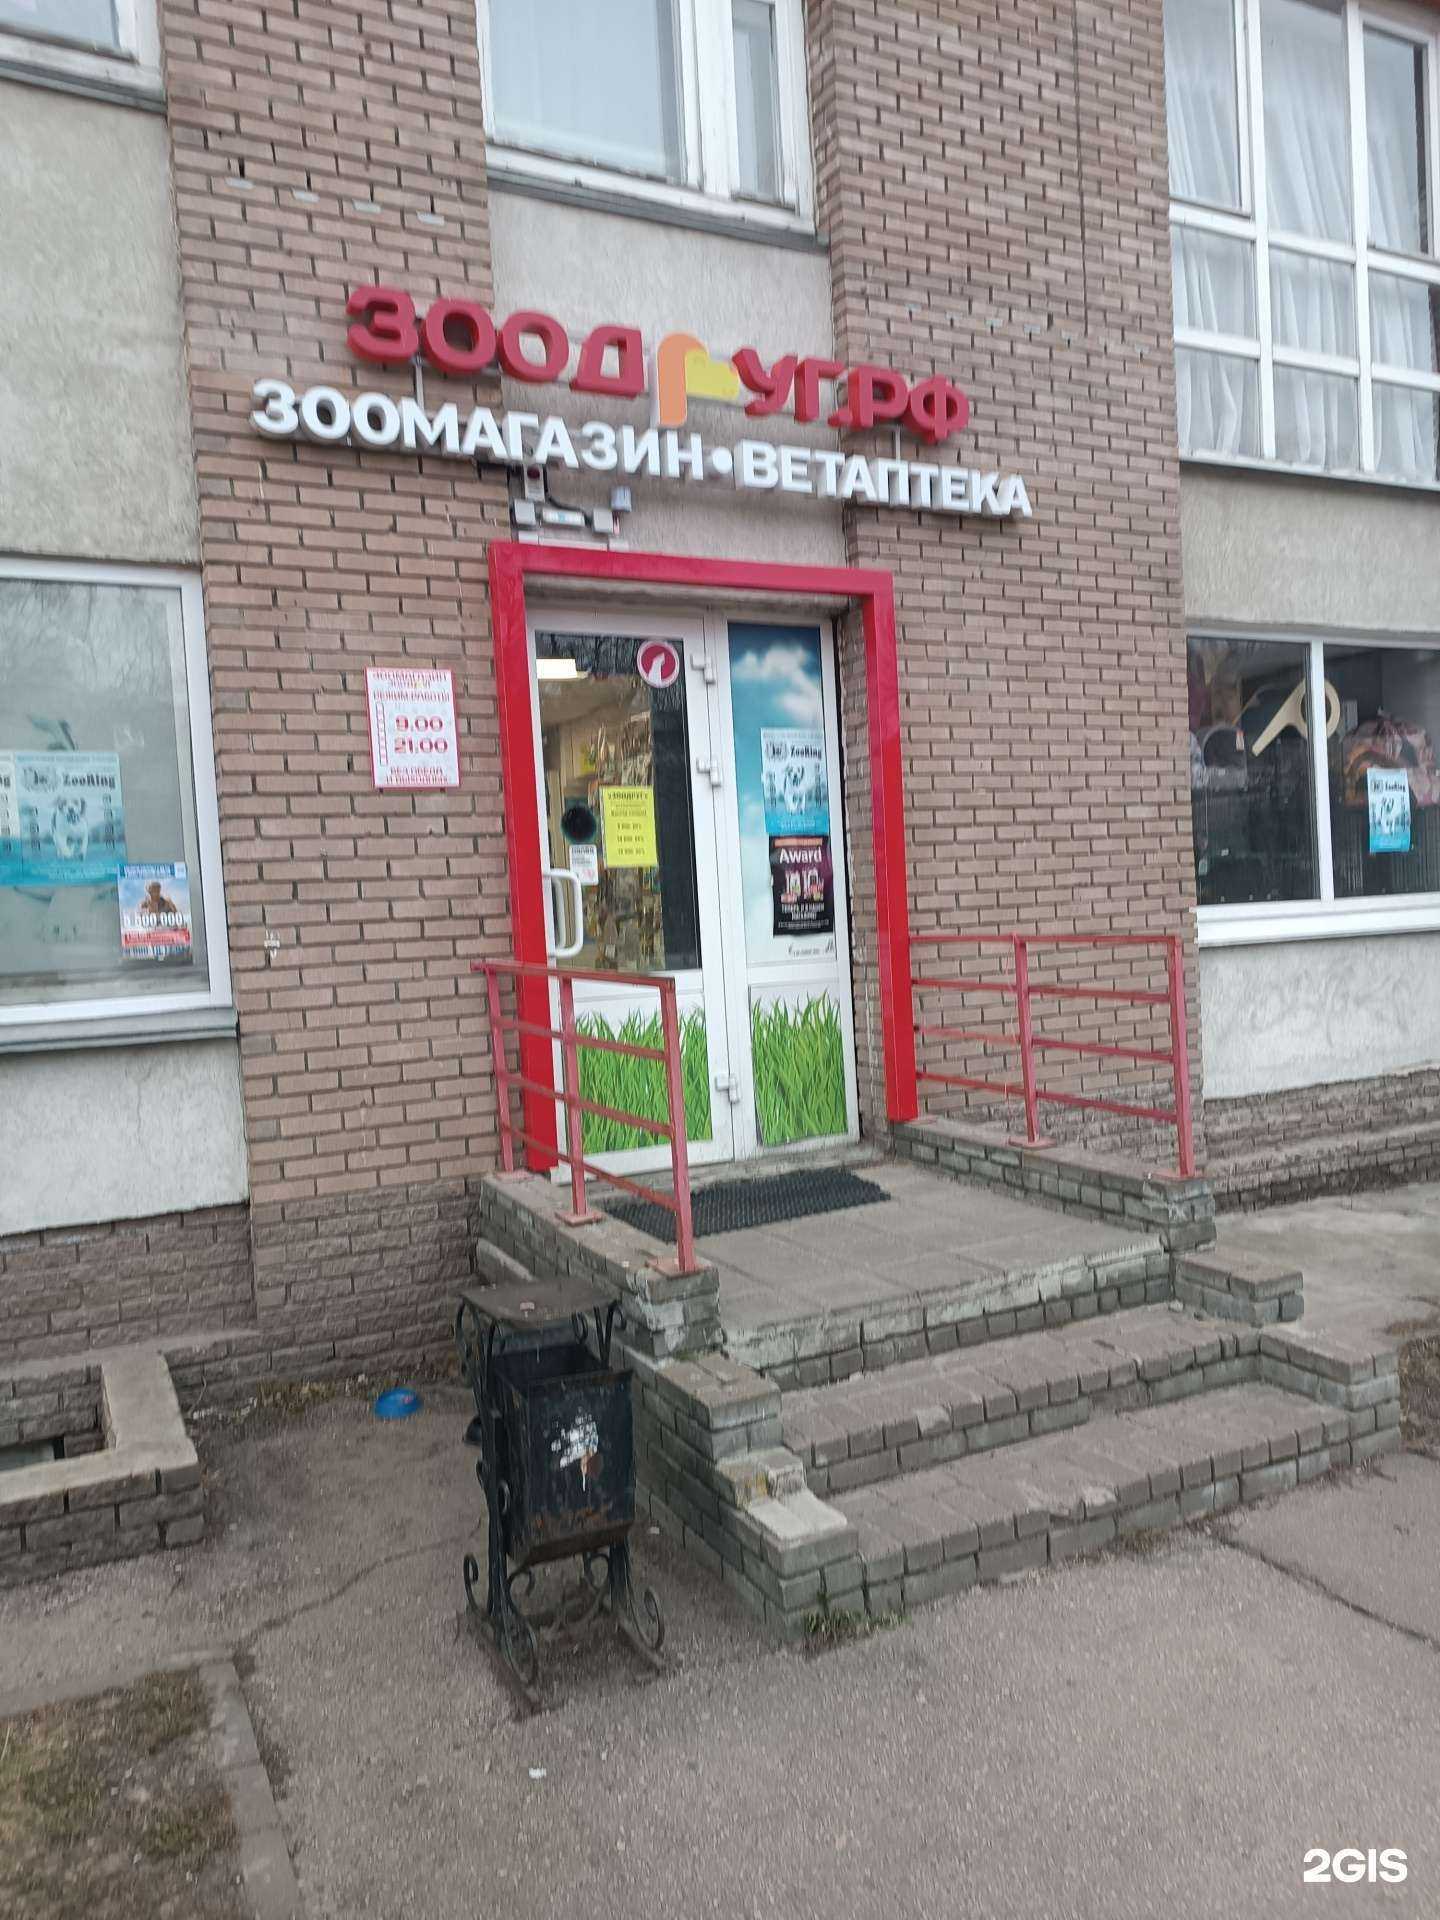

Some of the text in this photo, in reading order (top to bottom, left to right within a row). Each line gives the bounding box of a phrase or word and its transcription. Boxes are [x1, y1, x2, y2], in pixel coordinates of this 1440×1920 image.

[250, 377, 1034, 518] ЗООМАГАЗИН ВЕТАПТЕКА
[395, 714, 443, 733] 9.00
[394, 736, 448, 754] 21.00
[779, 846, 823, 863] Award
